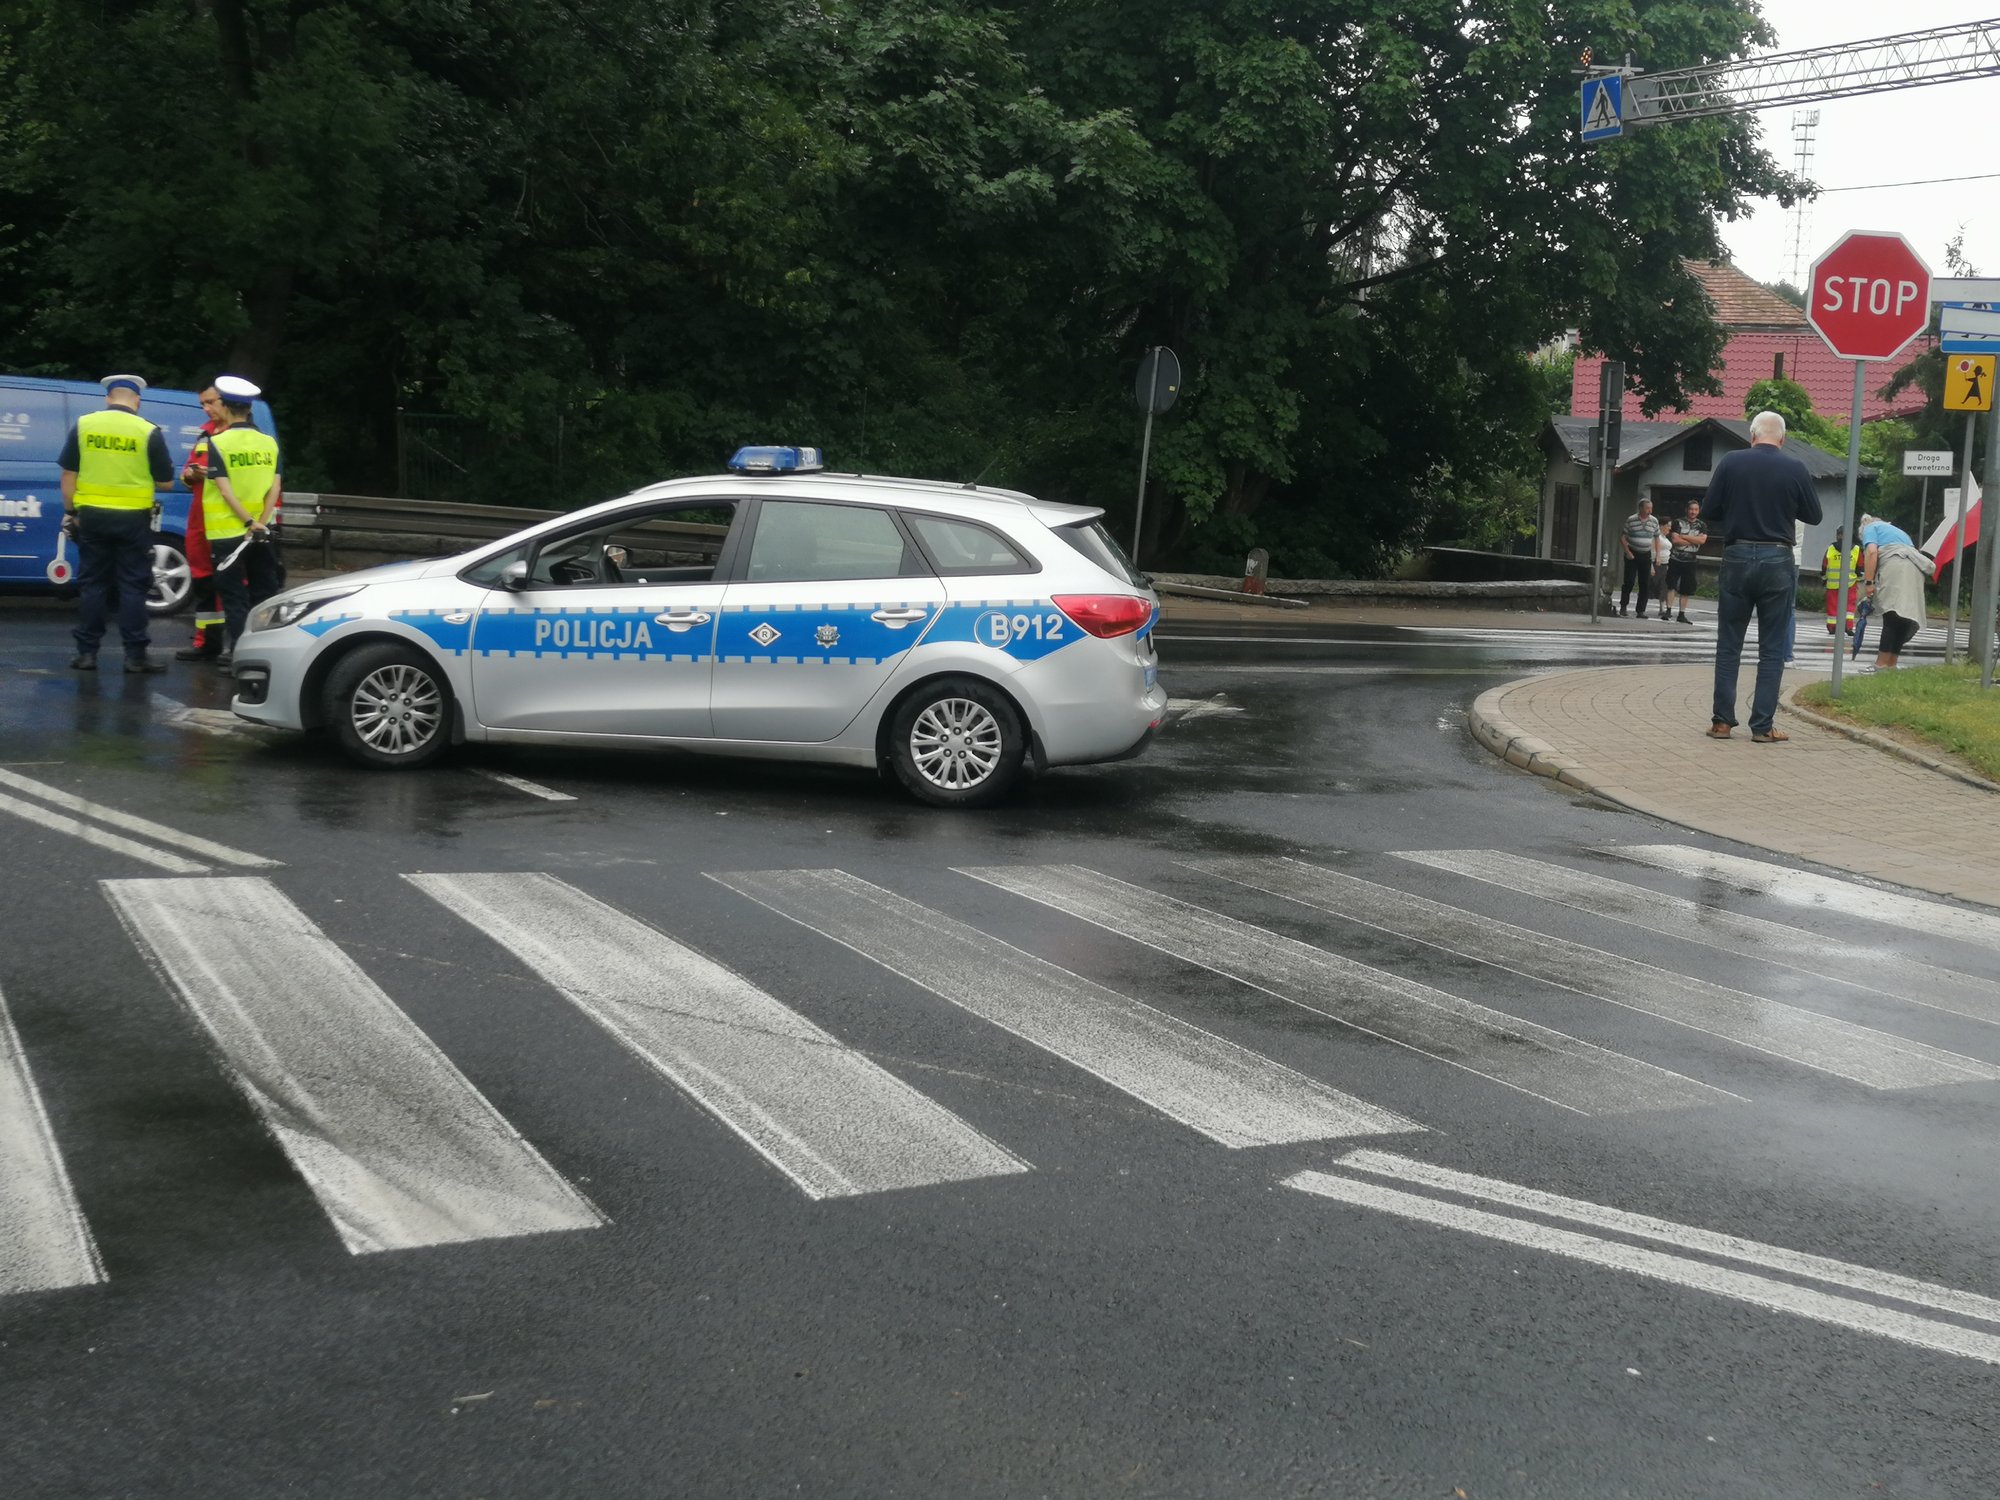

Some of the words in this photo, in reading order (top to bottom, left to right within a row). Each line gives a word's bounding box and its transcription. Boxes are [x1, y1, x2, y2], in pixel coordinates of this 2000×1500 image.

[1822, 275, 1918, 316] STOP
[86, 434, 137, 452] POLICJA
[230, 452, 273, 468] POLICJA
[1917, 454, 1941, 463] Droga
[535, 619, 653, 648] POLICJA
[991, 614, 1064, 640] B912
